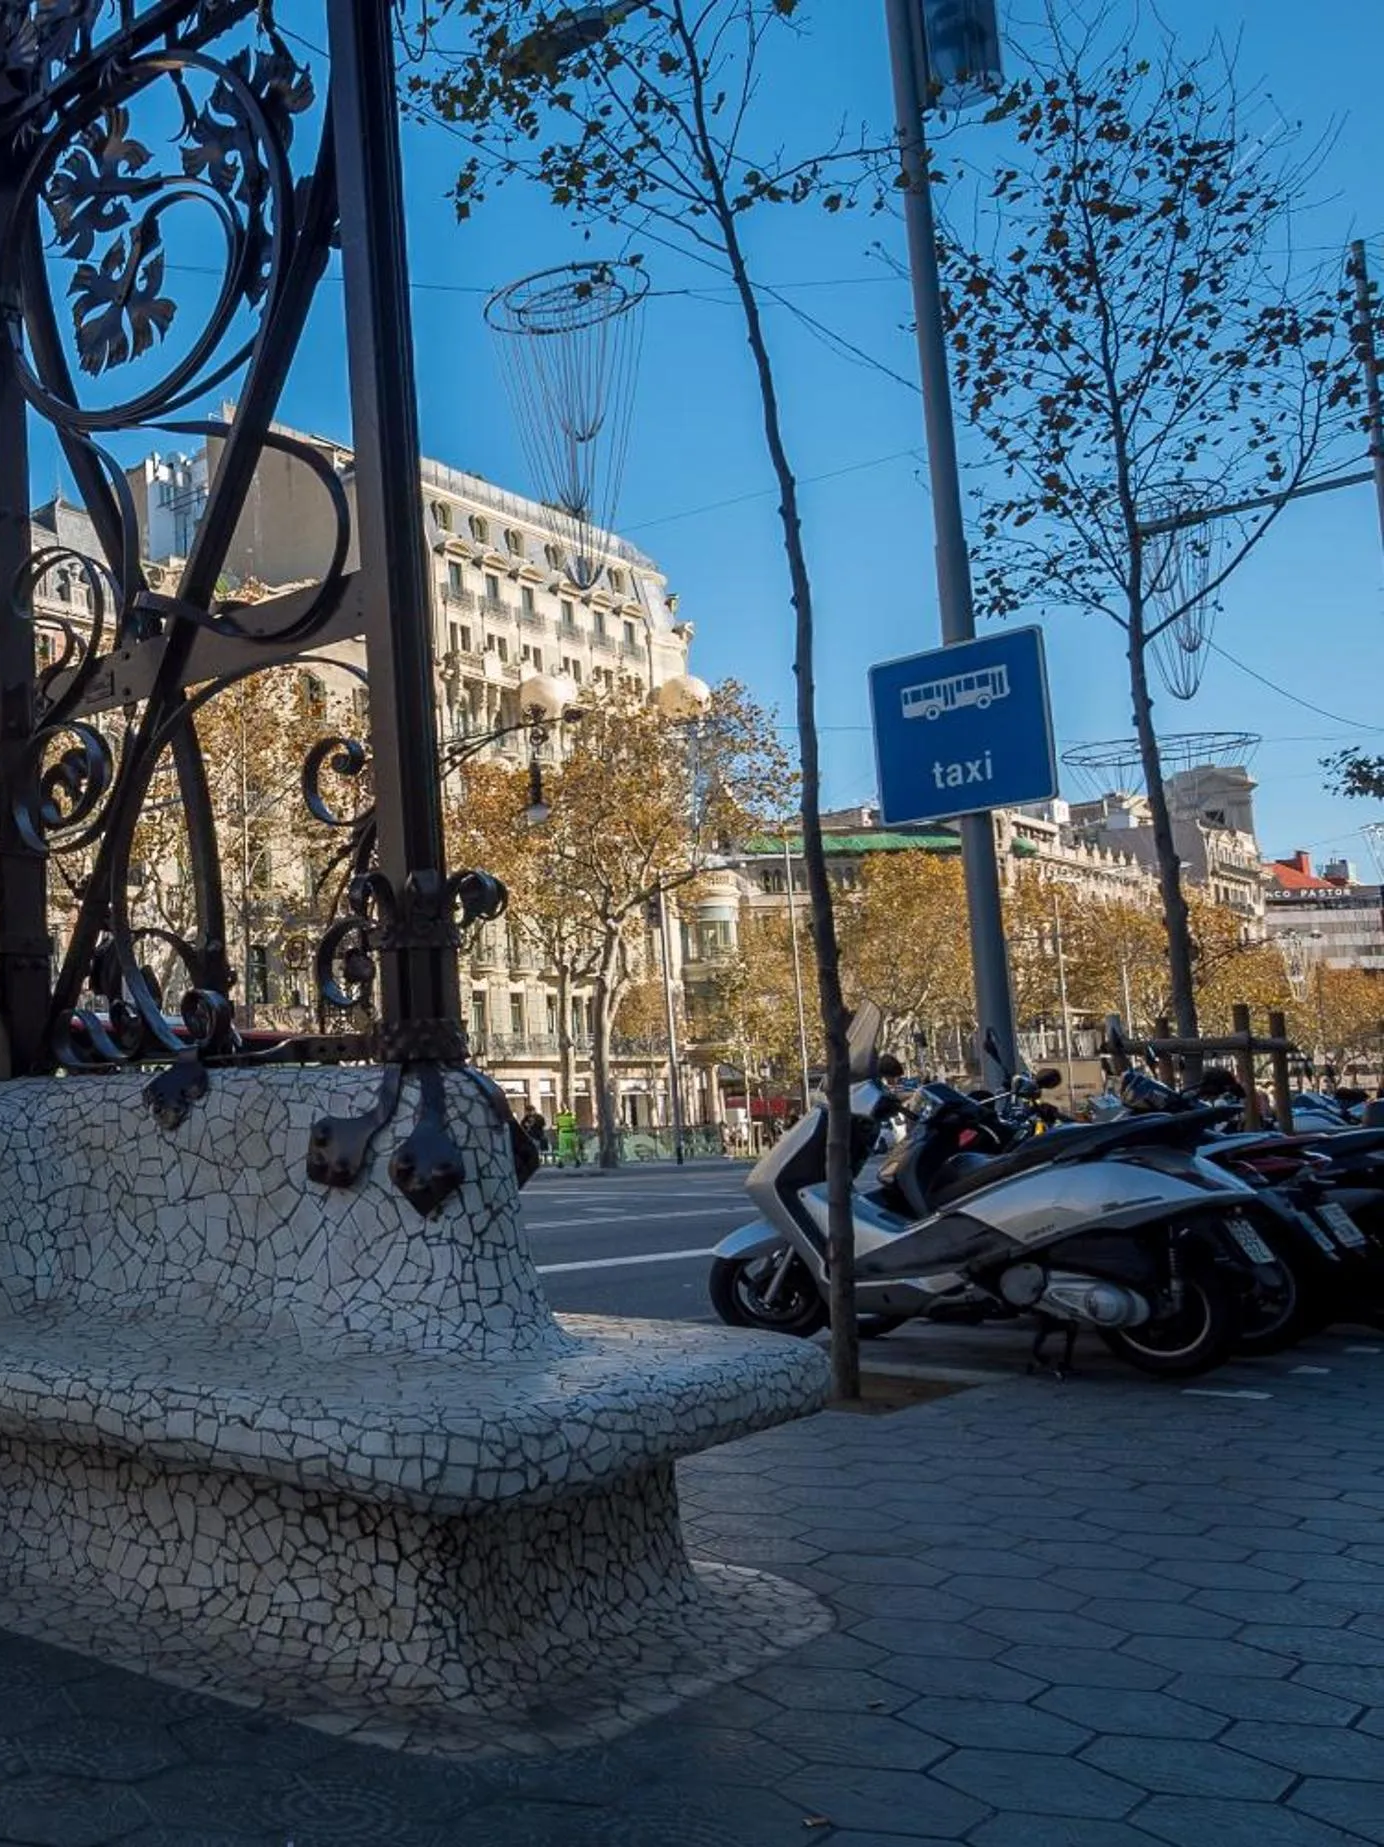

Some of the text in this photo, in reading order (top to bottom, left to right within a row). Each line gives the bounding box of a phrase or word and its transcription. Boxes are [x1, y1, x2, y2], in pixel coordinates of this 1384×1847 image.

[932, 749, 993, 789] taxi
[1265, 888, 1351, 898] NCO PASTOR
